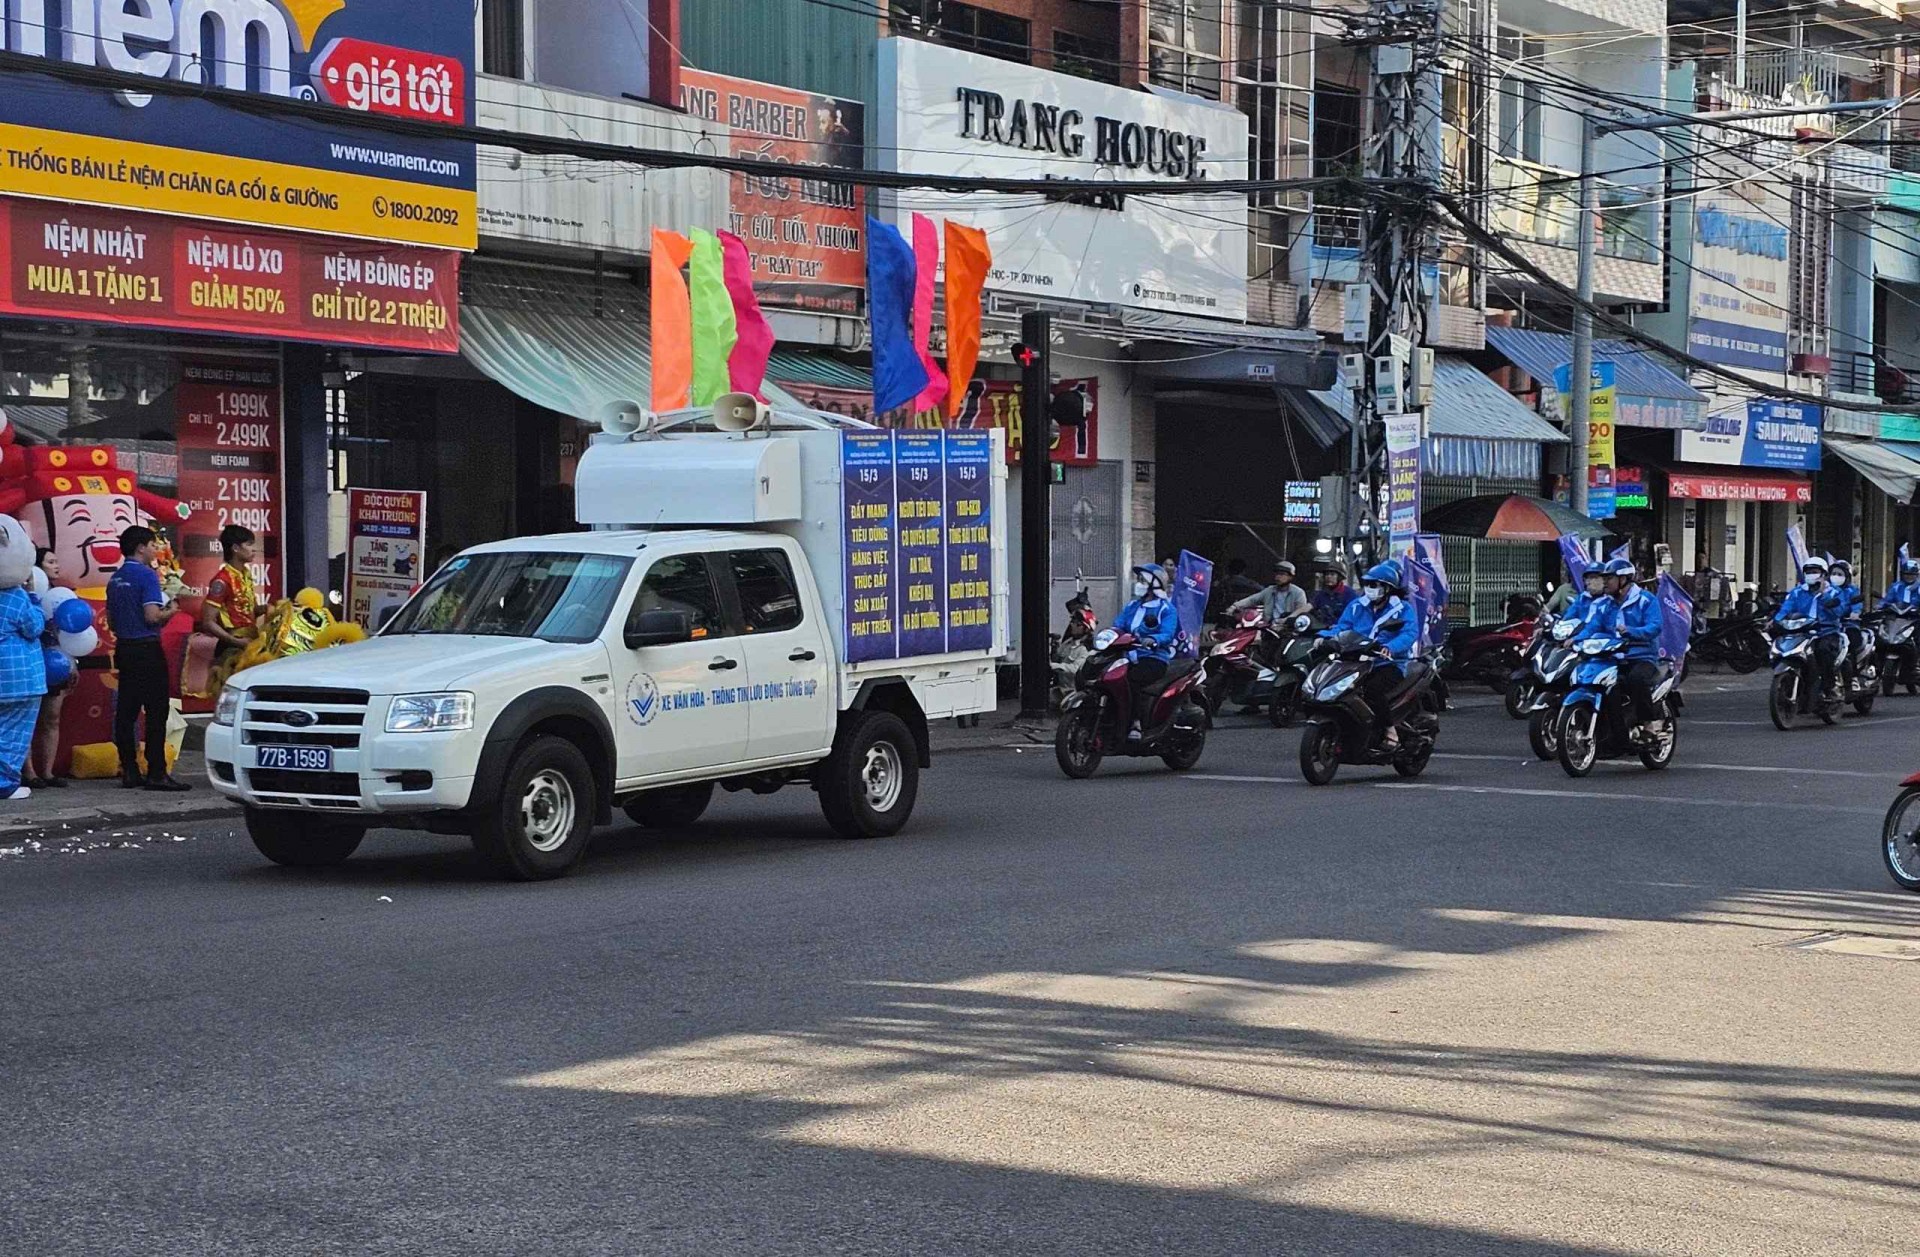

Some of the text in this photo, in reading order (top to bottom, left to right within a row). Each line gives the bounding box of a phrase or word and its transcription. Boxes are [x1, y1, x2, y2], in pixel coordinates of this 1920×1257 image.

[346, 57, 454, 117] giá tốt
[679, 82, 808, 141] ANG BARBER
[331, 143, 459, 177] www.vuanem.com
[1094, 116, 1208, 181] HOUSE
[7, 147, 338, 210] THỐNG BÁN LẺ NỆM CHĂN GA GỐI & GIƯỜNG
[390, 201, 458, 226] 1800.2092
[752, 211, 777, 243] GỘI,
[44, 218, 146, 264] NỆM NHẬT
[188, 235, 283, 275] NỆM LÒ XO
[27, 264, 163, 304] MUA 1 TẶNG 1
[324, 251, 434, 291] NỆM BÔNG ÉP
[191, 274, 285, 314] GIẢM 50%
[312, 288, 446, 334] CHỈ TỪ 2.2 TRIỆU
[216, 392, 269, 418] 1.999K
[217, 422, 270, 447] 2.499K
[229, 456, 250, 467] FOAM
[859, 468, 878, 483] 15/3
[911, 467, 928, 482] 15/3
[959, 466, 977, 480] 15/3
[1719, 482, 1739, 499] SÁCH
[661, 694, 672, 711] XE
[673, 689, 688, 710] VĂN
[690, 688, 705, 708] HÓA
[712, 685, 735, 706] THÔNG
[737, 686, 749, 703] TIN
[261, 747, 327, 768] 77B-1599
